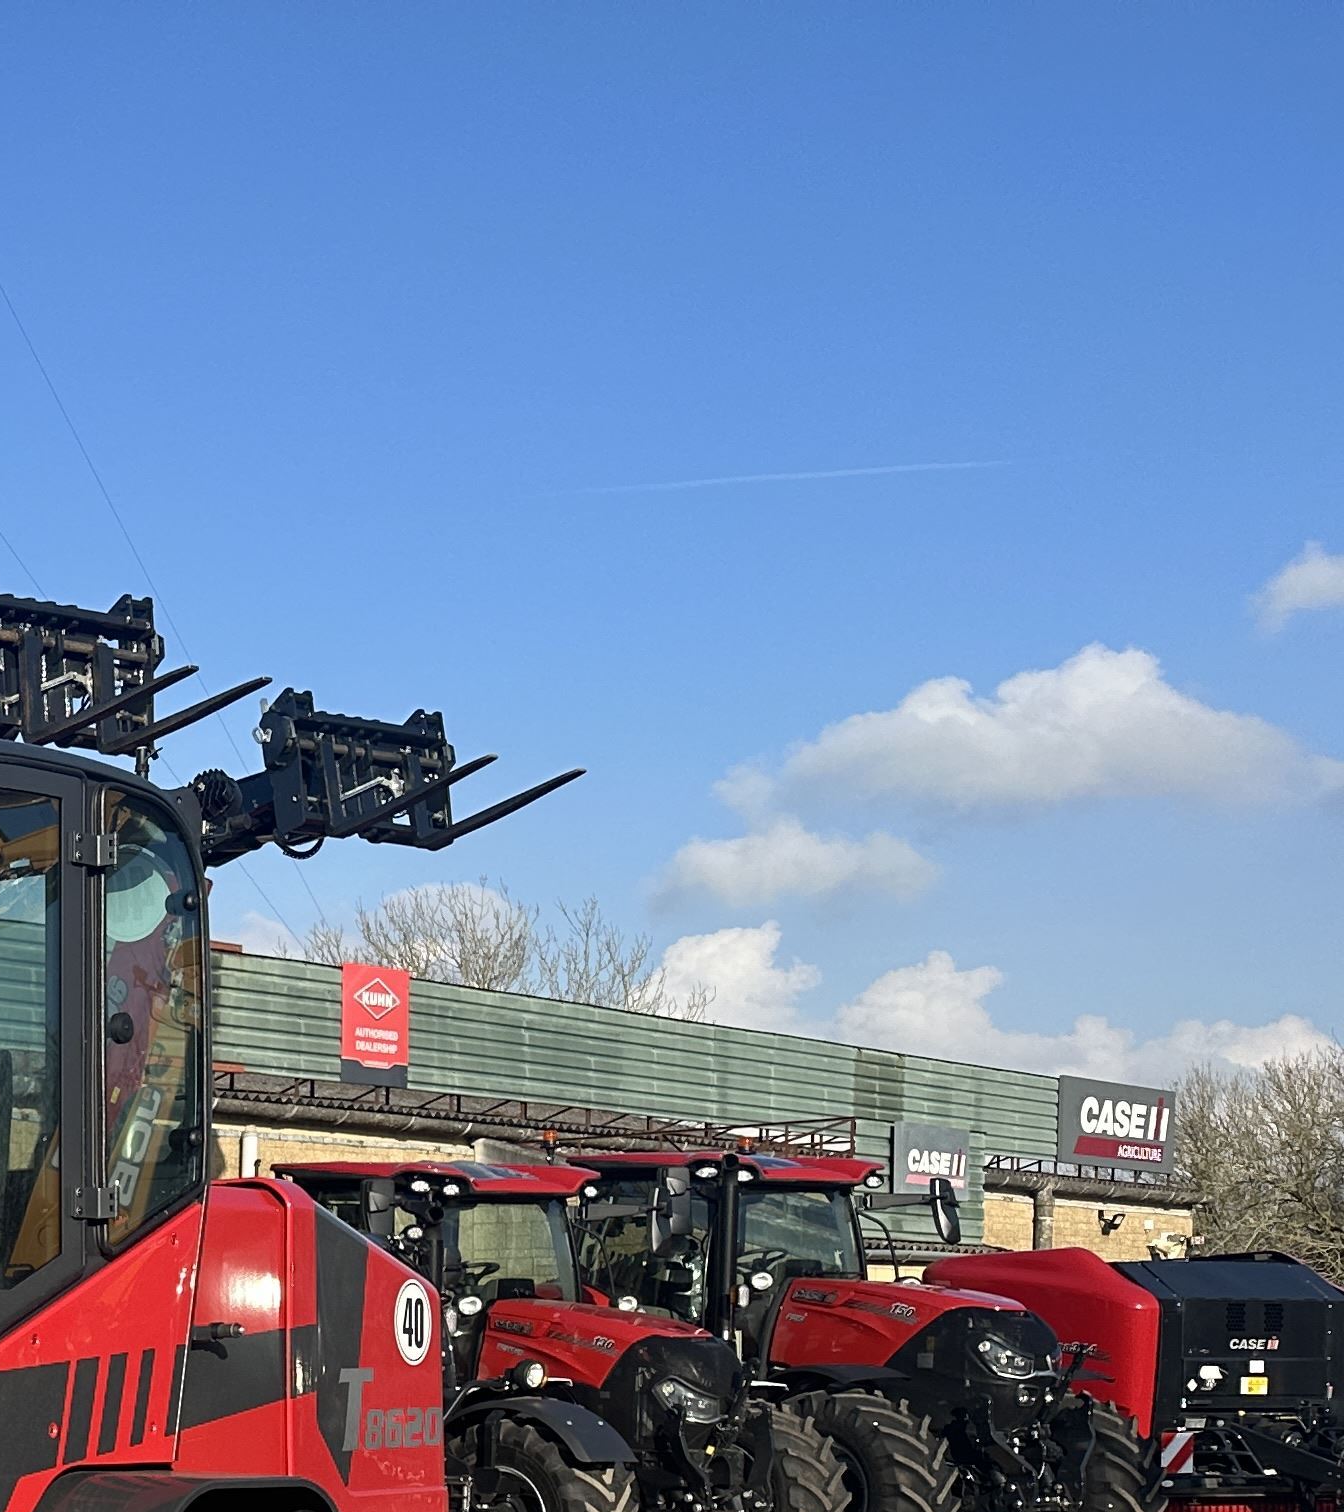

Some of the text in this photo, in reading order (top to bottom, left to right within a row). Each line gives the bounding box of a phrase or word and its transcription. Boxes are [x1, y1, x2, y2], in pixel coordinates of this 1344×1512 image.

[362, 991, 393, 1007] KUHN
[1080, 1096, 1147, 1139] CASE
[908, 1148, 951, 1175] CASE
[889, 1302, 916, 1318] 150
[403, 1298, 424, 1348] 40
[1229, 1338, 1266, 1350] CASE
